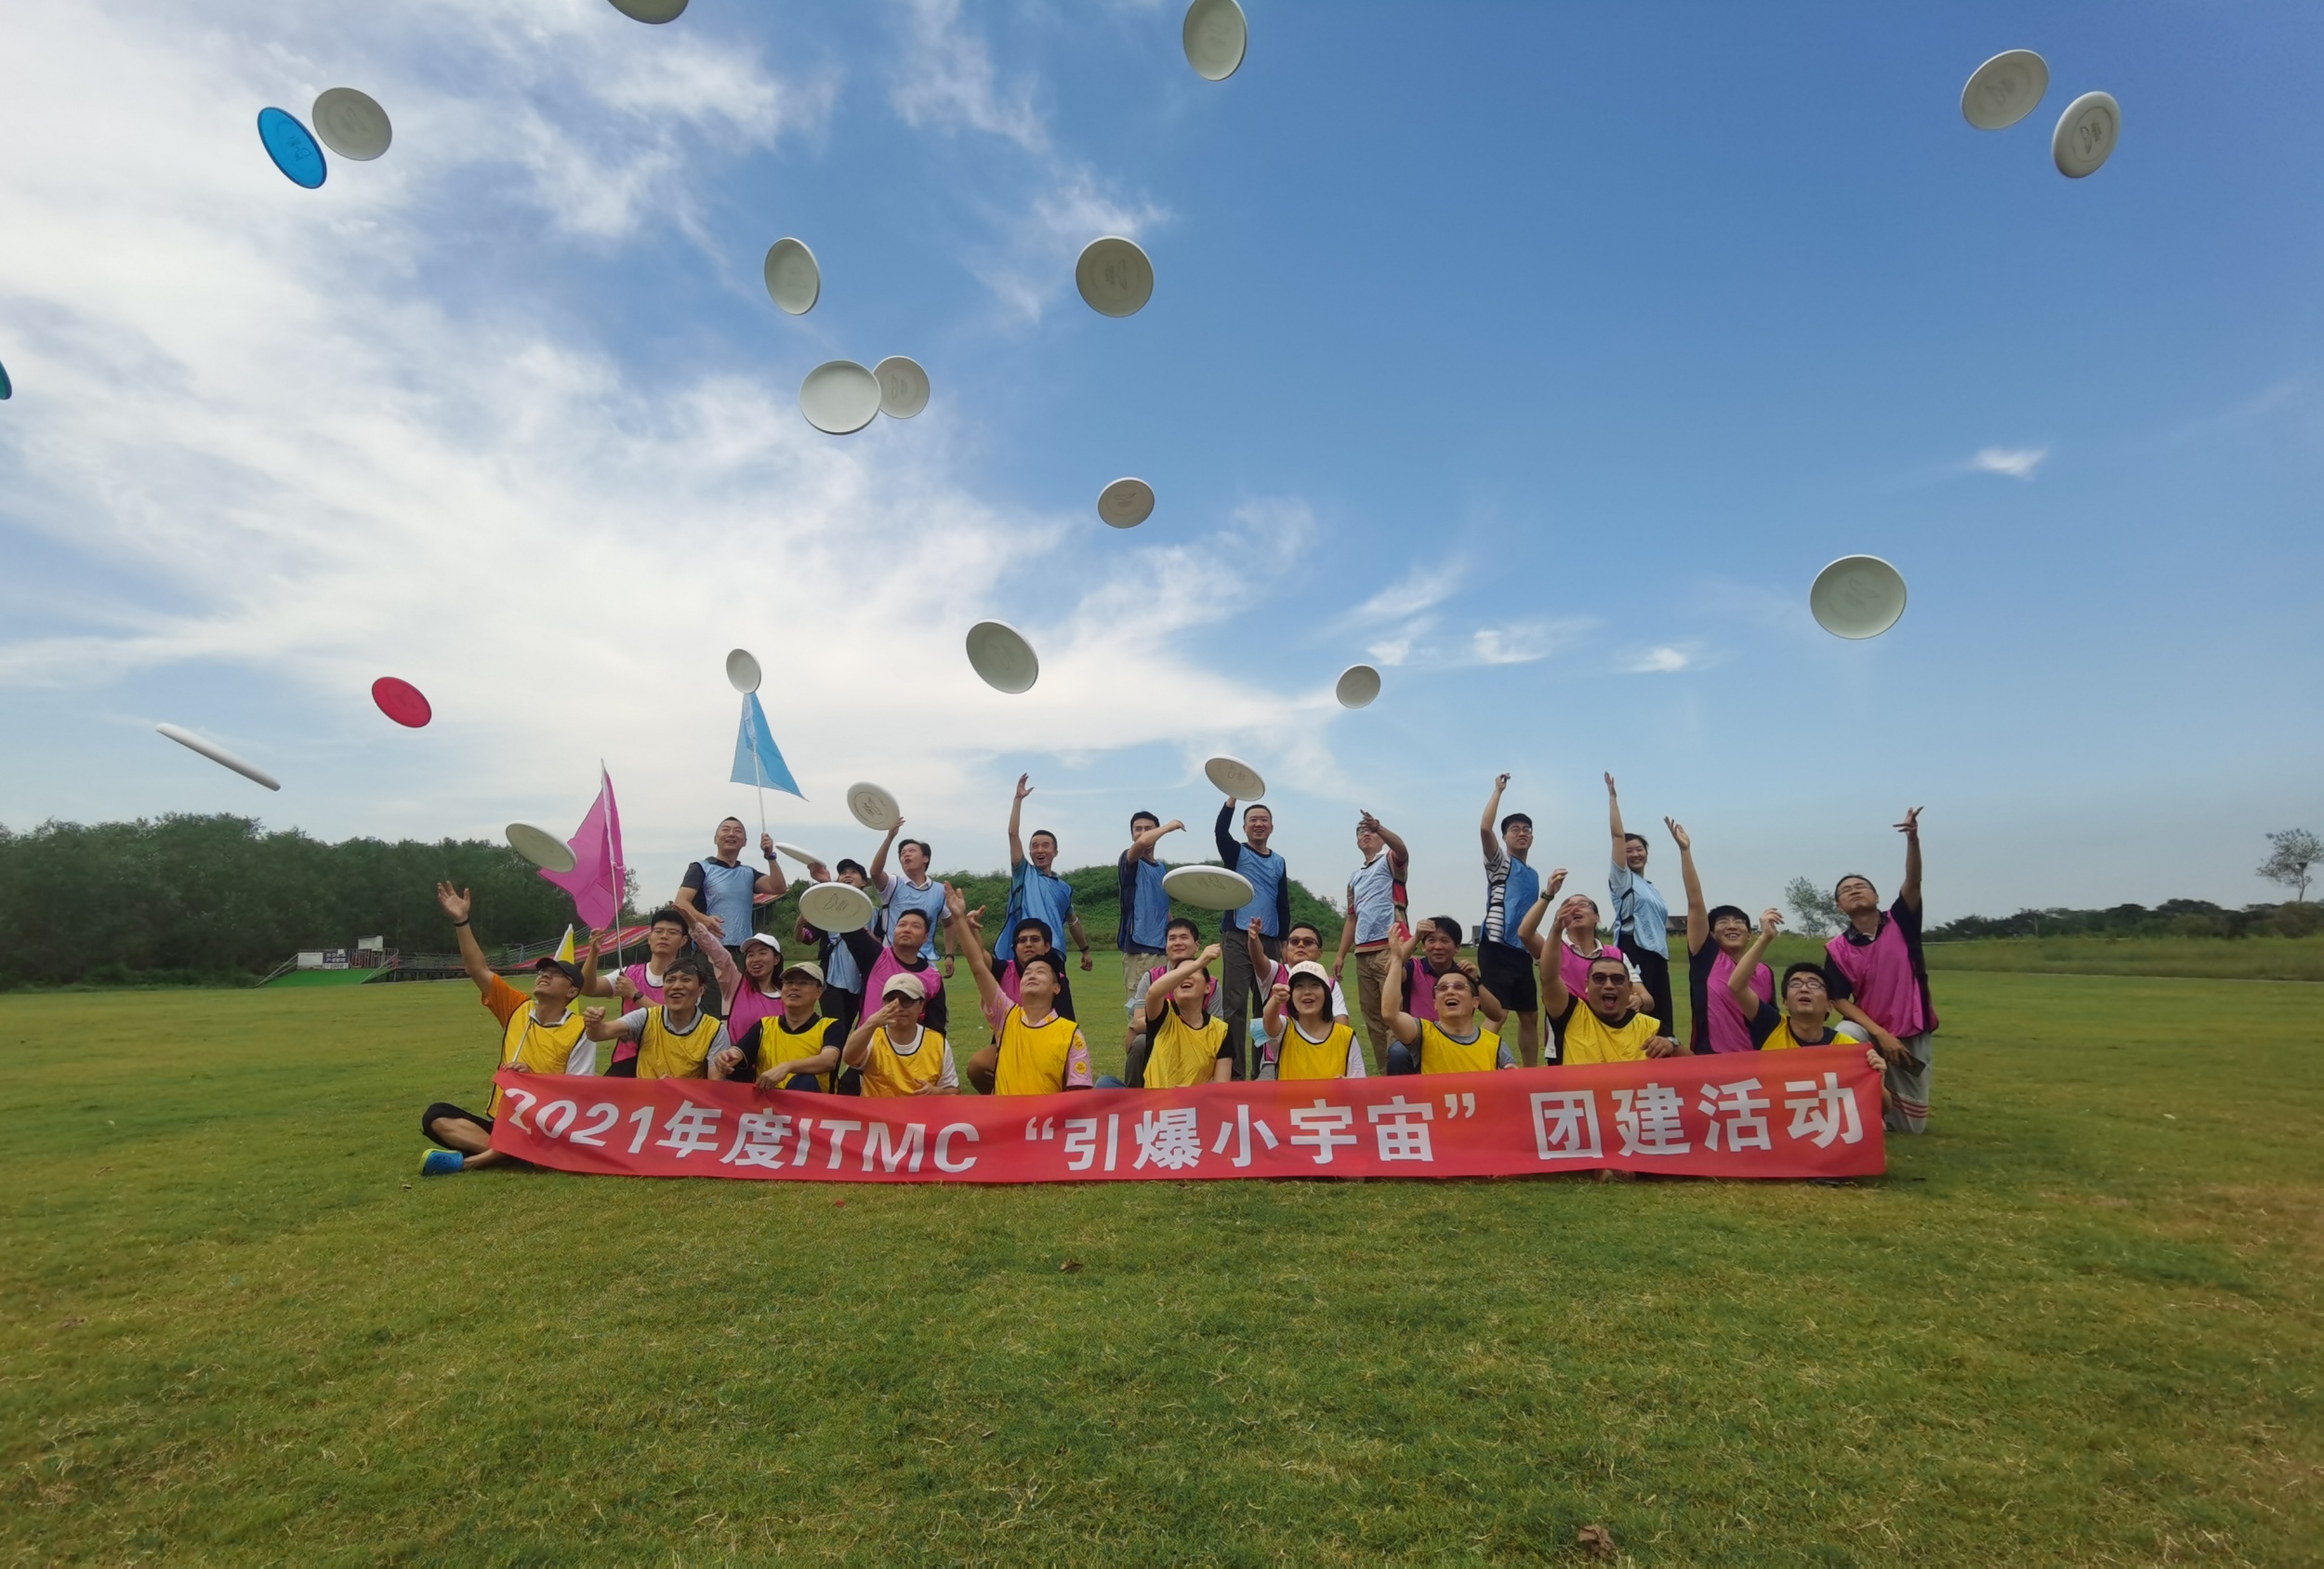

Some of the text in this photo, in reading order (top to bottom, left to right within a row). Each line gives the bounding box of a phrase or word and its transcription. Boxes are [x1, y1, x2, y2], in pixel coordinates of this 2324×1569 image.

[1024, 1092, 1476, 1171] “引爆小宇宙”
[1529, 1072, 1864, 1160] 团建活动
